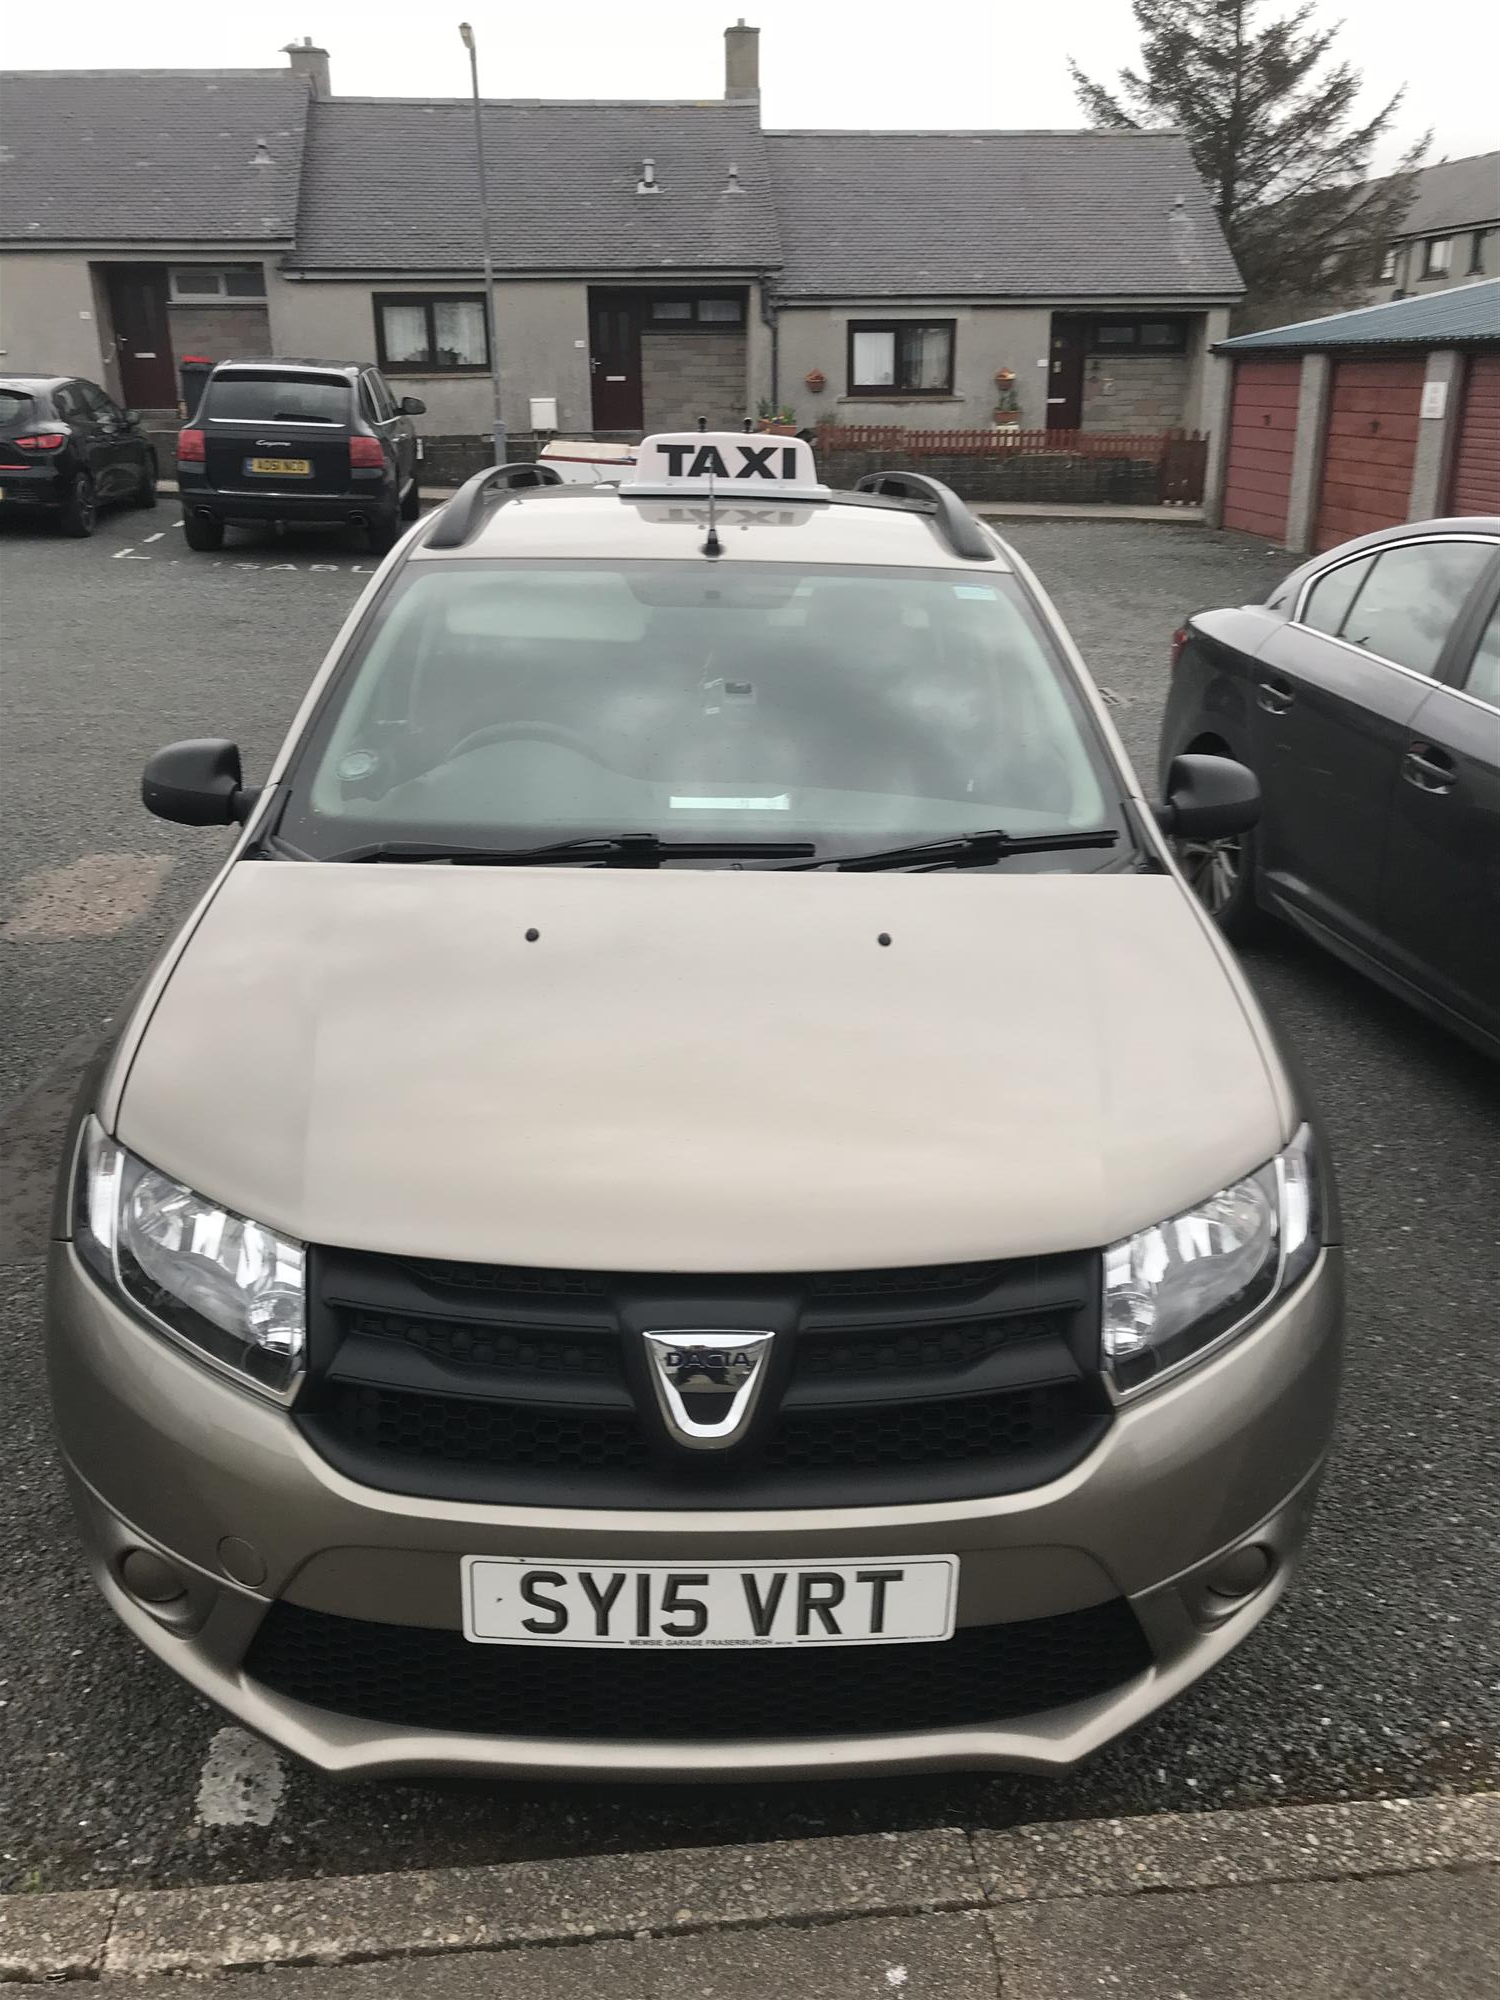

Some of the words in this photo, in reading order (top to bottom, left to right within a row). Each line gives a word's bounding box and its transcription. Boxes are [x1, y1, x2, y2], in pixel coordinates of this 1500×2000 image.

[656, 443, 797, 480] TAXI
[666, 1351, 751, 1369] DACIA
[519, 1570, 709, 1637] SY15
[740, 1569, 904, 1636] VRT
[665, 1639, 703, 1647] GARAGE
